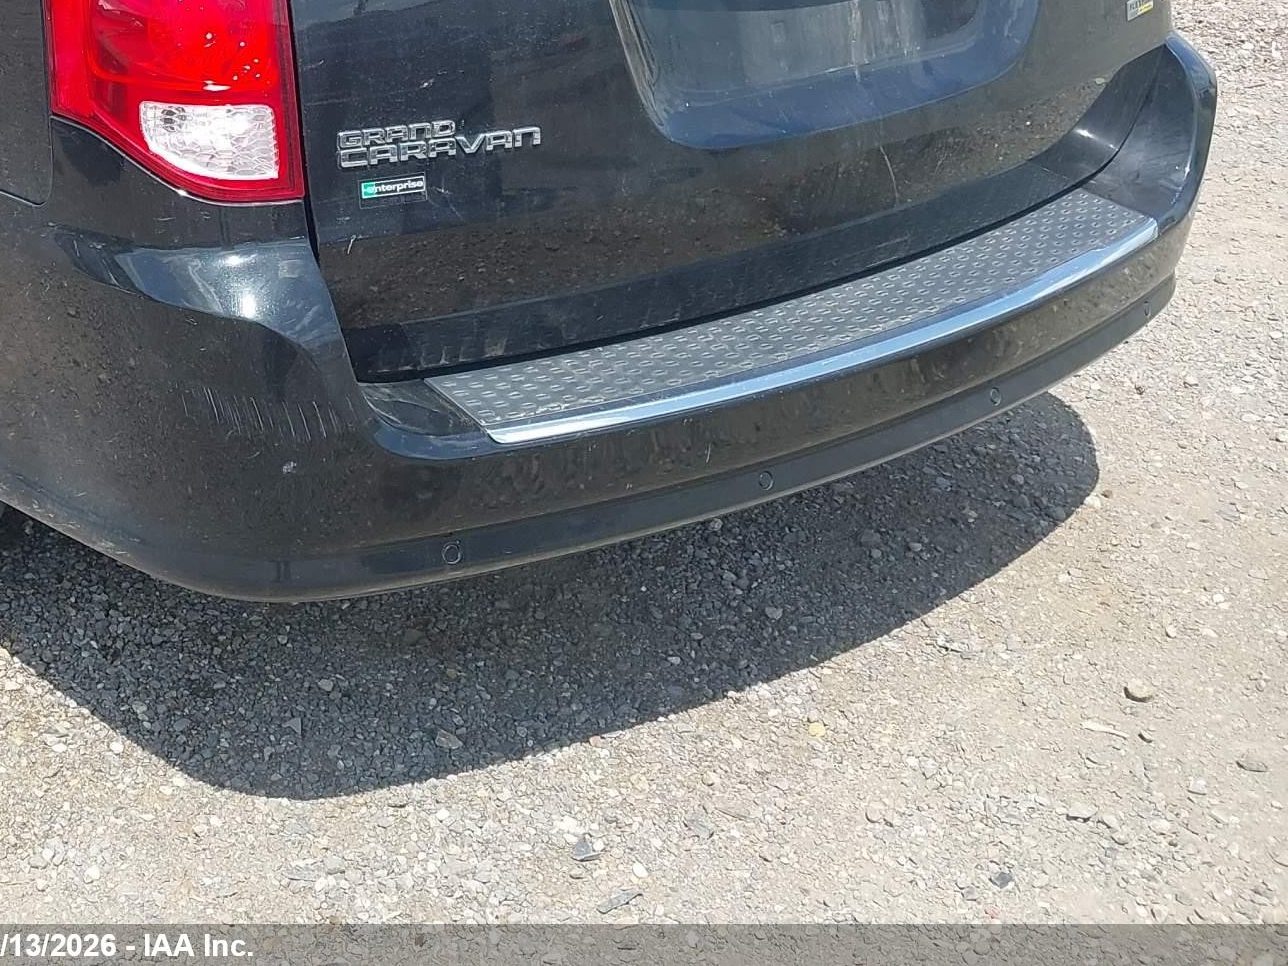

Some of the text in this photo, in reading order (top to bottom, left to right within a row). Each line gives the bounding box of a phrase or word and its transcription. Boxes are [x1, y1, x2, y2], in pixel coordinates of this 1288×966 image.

[338, 120, 456, 149] GRAND
[339, 126, 542, 168] CARAVAN
[364, 180, 424, 194] enterprise
